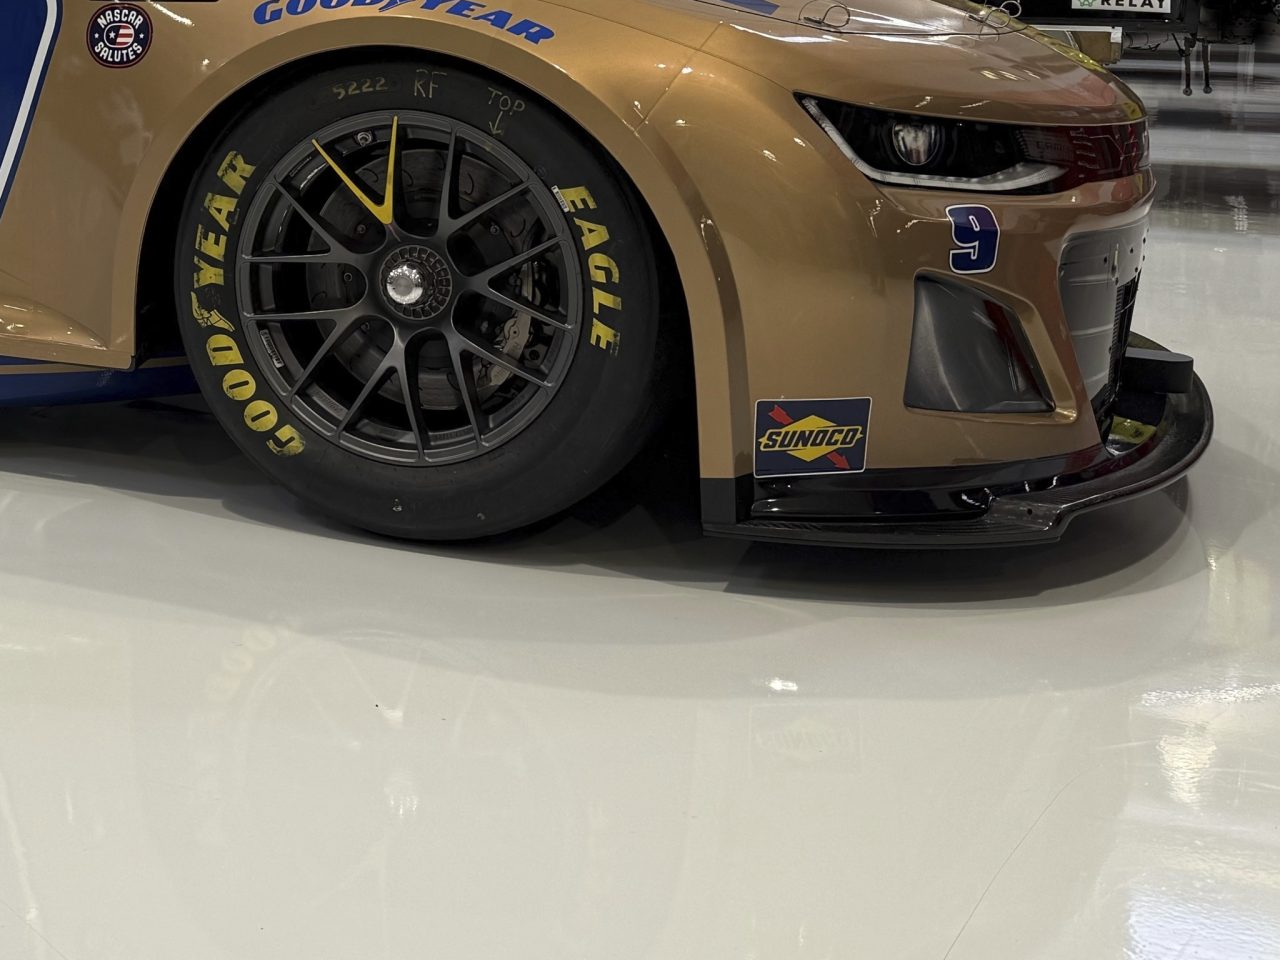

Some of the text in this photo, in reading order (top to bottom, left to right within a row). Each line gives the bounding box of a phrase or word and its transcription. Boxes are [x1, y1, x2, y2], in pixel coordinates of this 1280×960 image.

[97, 8, 144, 30] NASCAR
[94, 41, 143, 62] SALUTES
[487, 86, 526, 116] TOP
[946, 204, 1000, 274] 9
[559, 186, 622, 360] EAGLE
[191, 150, 306, 457] GOODYEAR
[762, 427, 860, 450] SUNOCO
